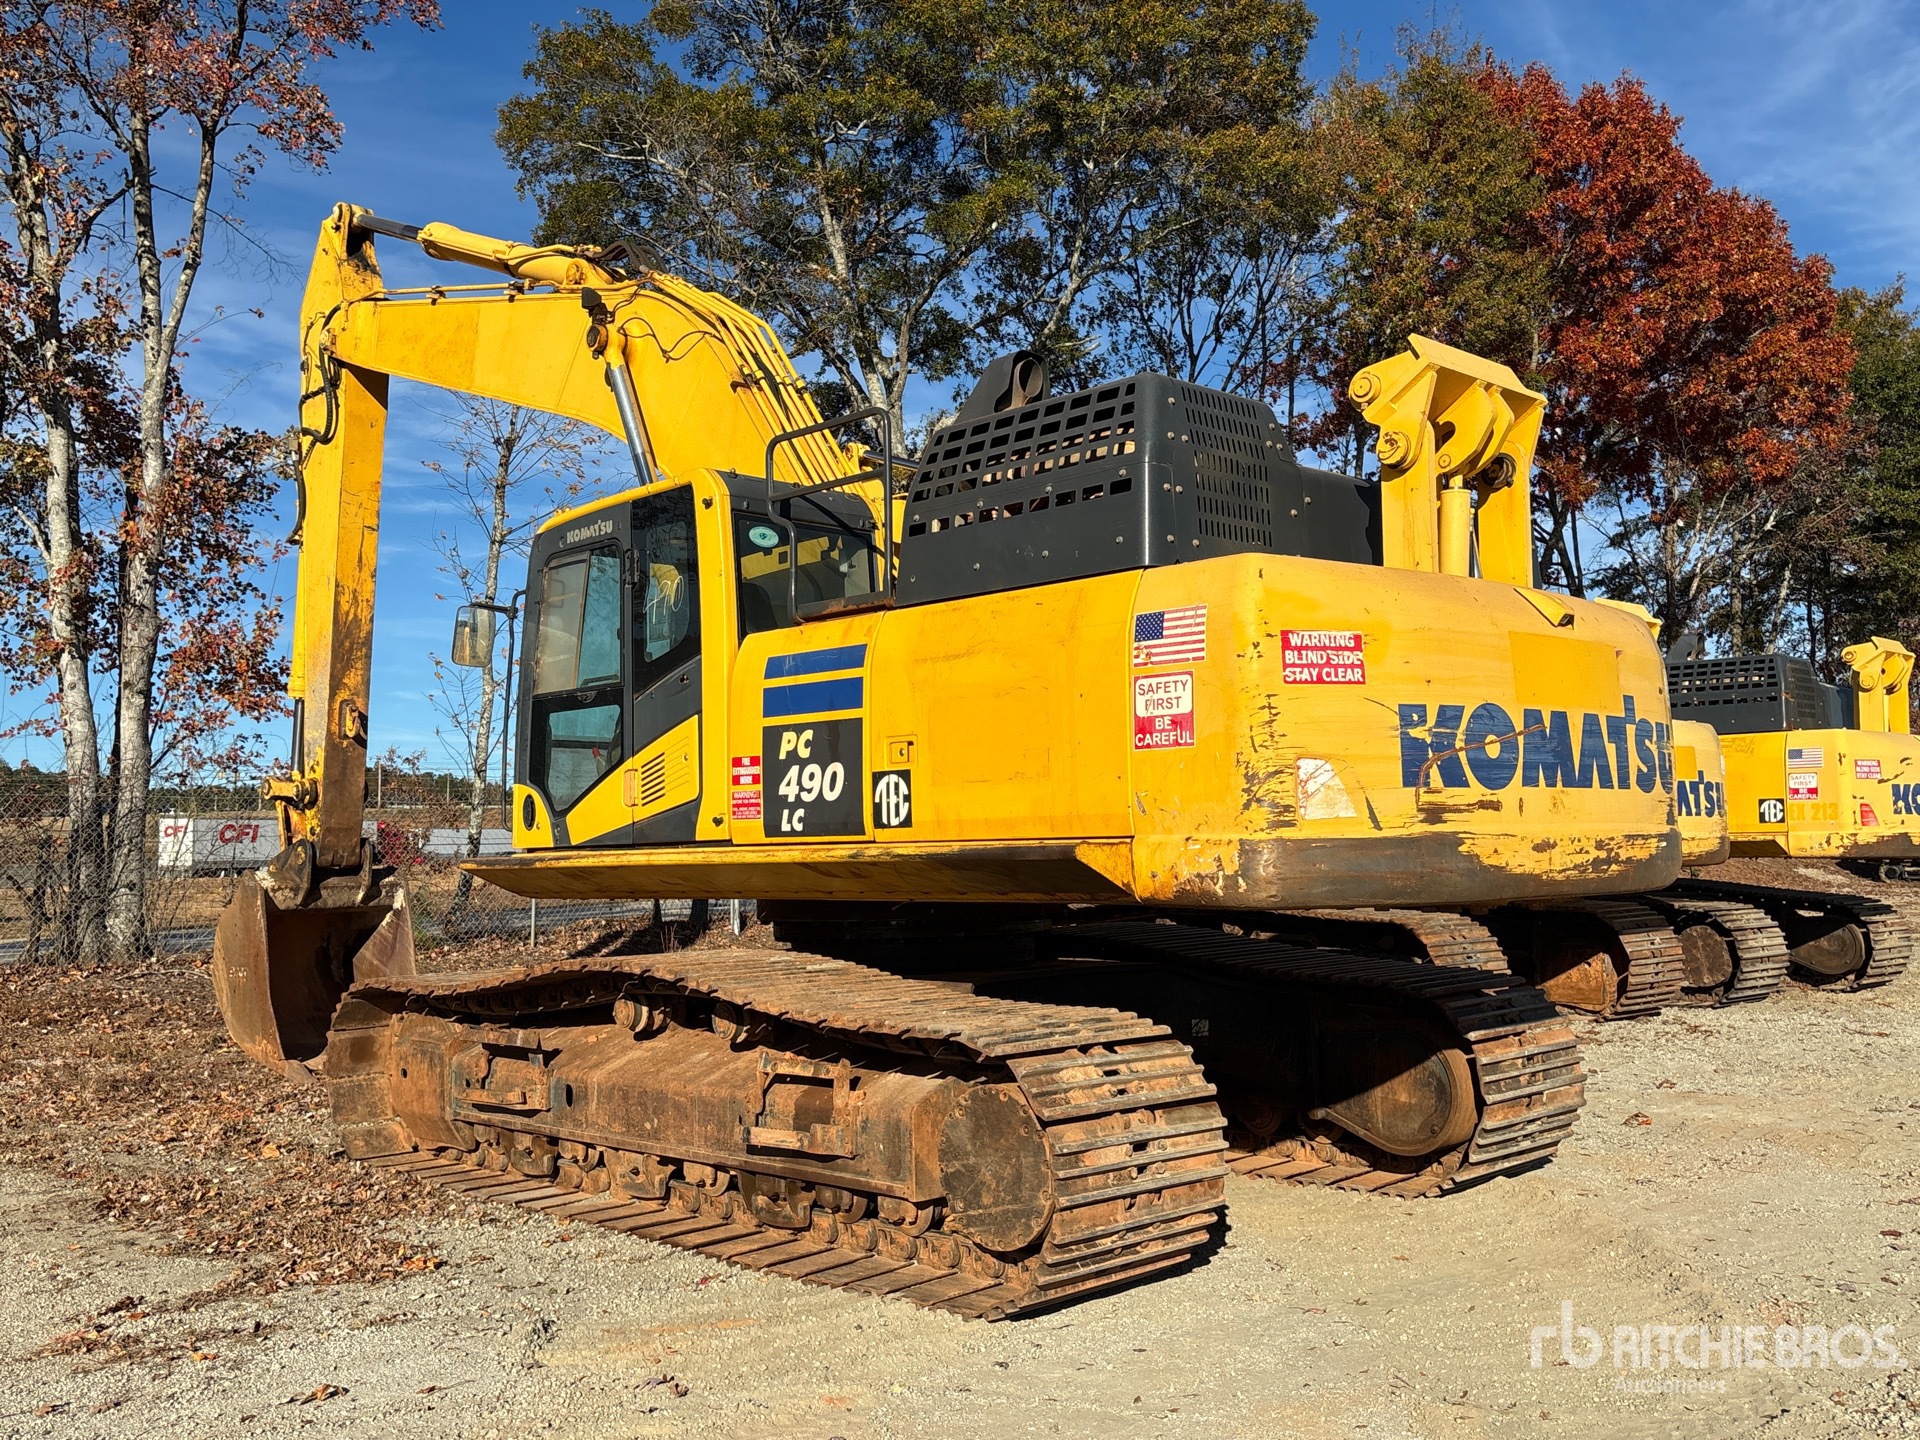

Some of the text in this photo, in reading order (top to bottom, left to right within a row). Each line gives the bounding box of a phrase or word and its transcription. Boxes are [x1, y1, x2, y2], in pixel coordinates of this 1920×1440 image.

[566, 519, 613, 544] KOMATSU
[1288, 632, 1355, 648] WARNING
[1284, 650, 1362, 666] BLIND SIDE
[1283, 667, 1363, 682] STAY CLEAR
[1137, 679, 1189, 696] SAFETY
[1144, 696, 1182, 711] FIRST
[1155, 716, 1172, 730] BE
[778, 729, 814, 760] PC
[1135, 729, 1194, 747] CAREFUL
[1398, 694, 1673, 794] KOMATSU
[778, 762, 845, 803] 490
[874, 773, 909, 827] TEC
[780, 808, 805, 832] LC
[1811, 803, 1838, 821] 213
[218, 824, 260, 844] CFI
